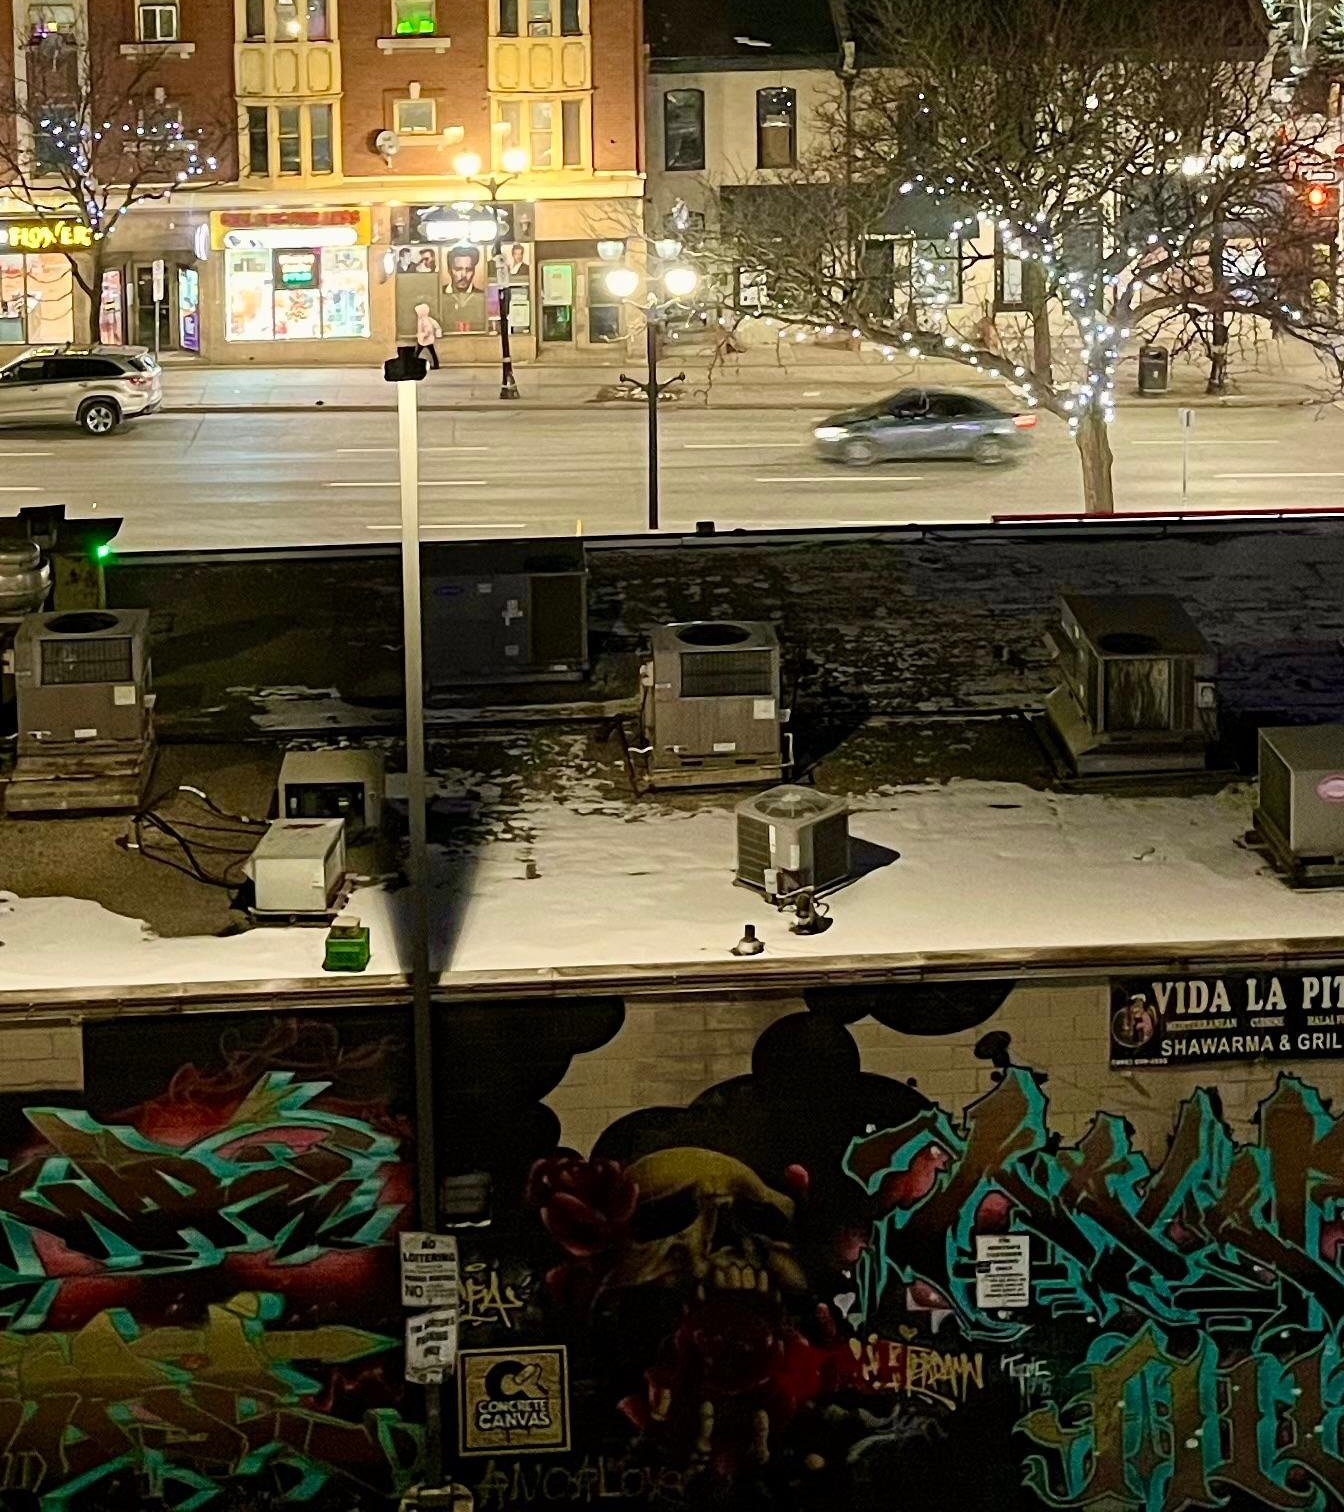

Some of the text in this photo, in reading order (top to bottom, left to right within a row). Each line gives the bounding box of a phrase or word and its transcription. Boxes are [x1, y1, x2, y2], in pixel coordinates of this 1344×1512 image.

[1151, 979, 1232, 1015] VIDA
[1246, 976, 1288, 1012] LA
[1160, 1034, 1275, 1057] SHAWARMA
[1278, 1034, 1292, 1051] &
[403, 1252, 456, 1263] LOITERING
[405, 1284, 424, 1298] NO
[477, 1399, 548, 1414] CONCRETE
[478, 1411, 551, 1430] CANVAS
